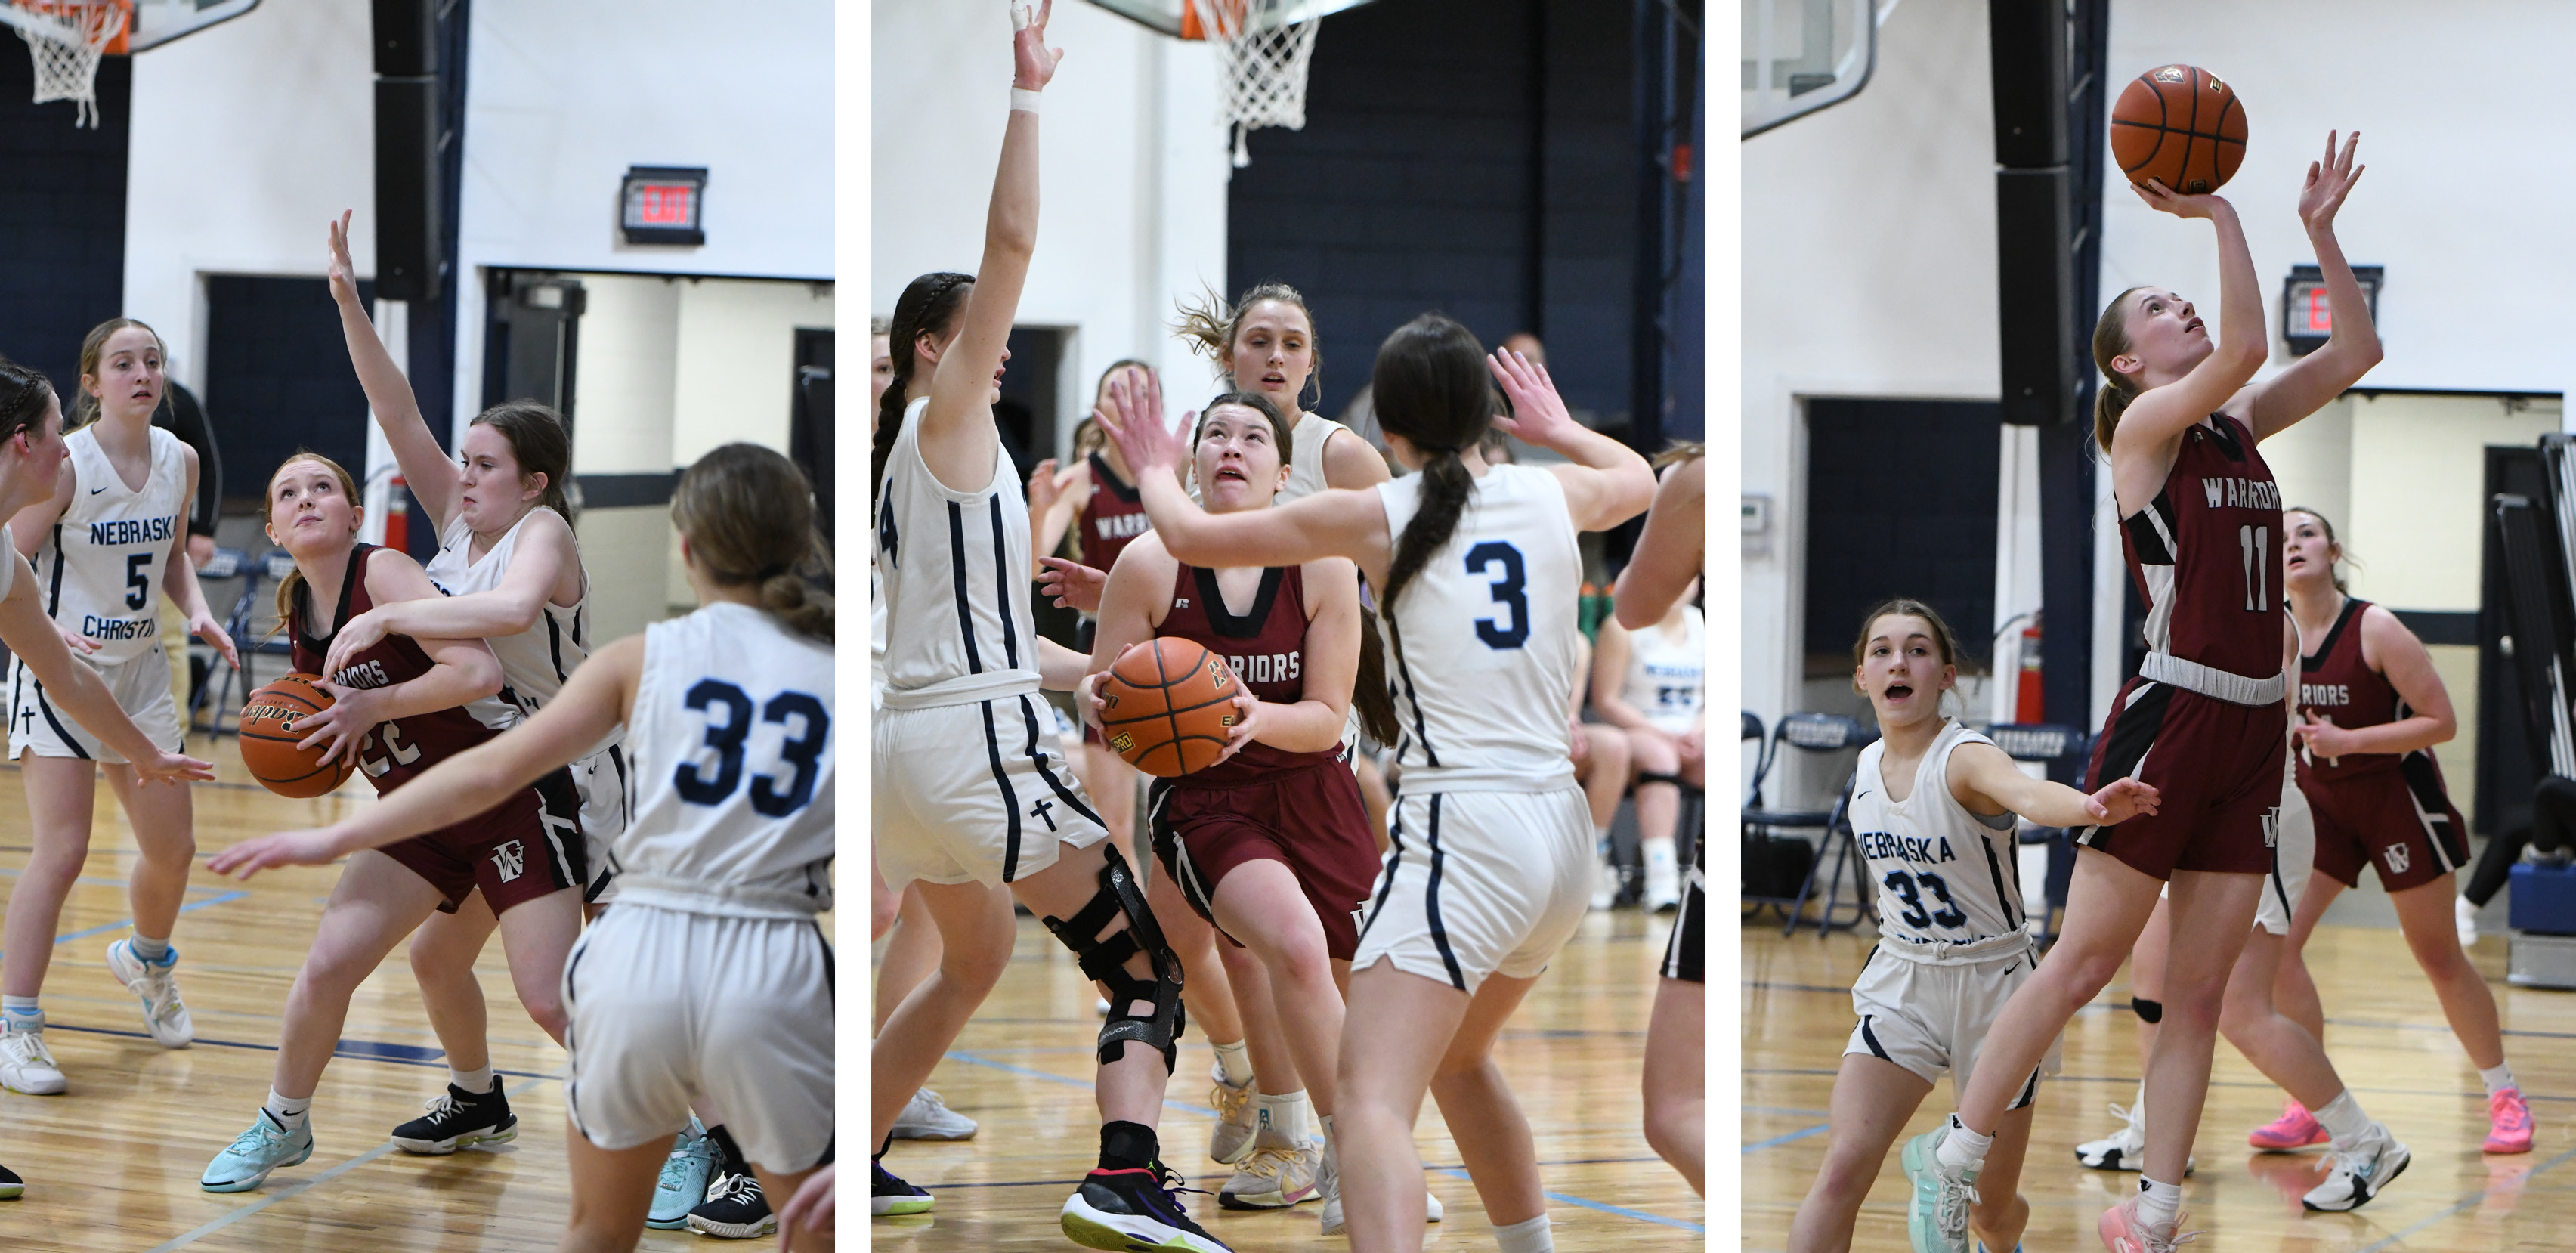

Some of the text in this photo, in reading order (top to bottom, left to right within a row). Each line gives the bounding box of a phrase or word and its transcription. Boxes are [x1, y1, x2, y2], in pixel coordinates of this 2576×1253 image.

[125, 552, 154, 611] 5
[1463, 539, 1531, 651] 3
[2240, 524, 2268, 611] 11
[332, 659, 390, 689] RIORS
[1216, 651, 1300, 683] RIORS
[673, 677, 830, 820] 33
[1882, 869, 1969, 930] 33
